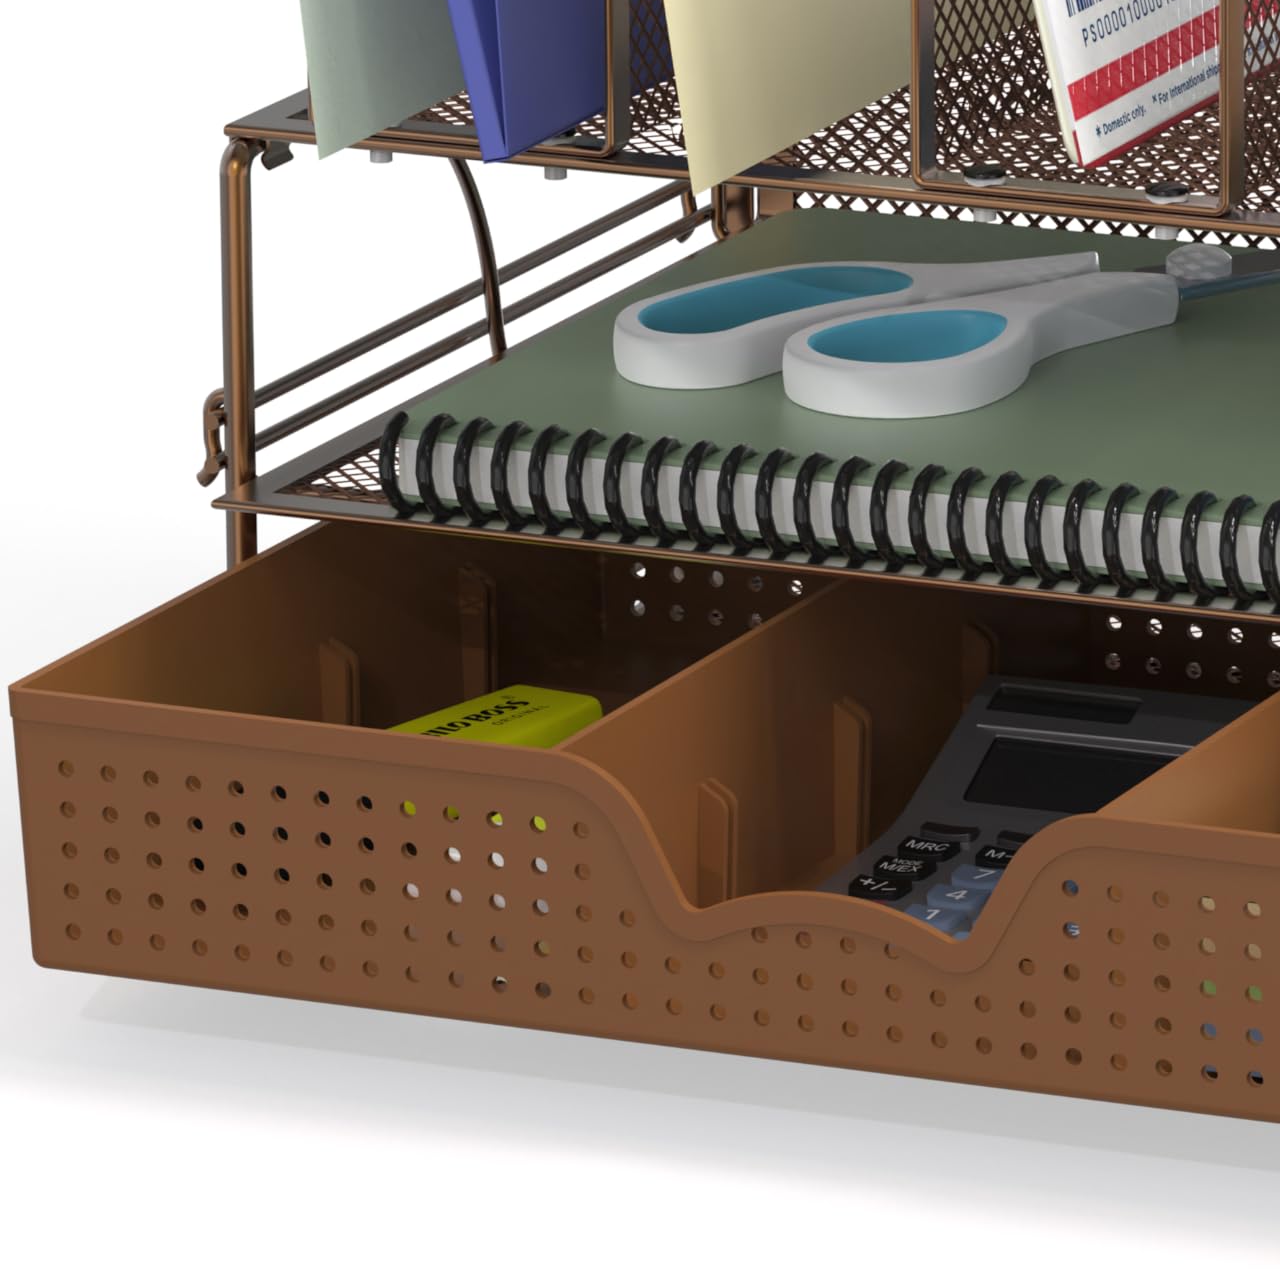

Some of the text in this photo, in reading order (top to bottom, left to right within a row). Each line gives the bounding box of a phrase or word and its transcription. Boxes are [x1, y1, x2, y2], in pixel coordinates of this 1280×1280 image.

[1102, 109, 1131, 136] Domestic
[463, 699, 530, 722] BOSS
[904, 838, 951, 852] MRC
[879, 861, 923, 874] M/EX
[892, 857, 924, 867] MODE
[971, 868, 997, 880] 7
[944, 888, 969, 900] 4
[925, 908, 942, 921] 1
